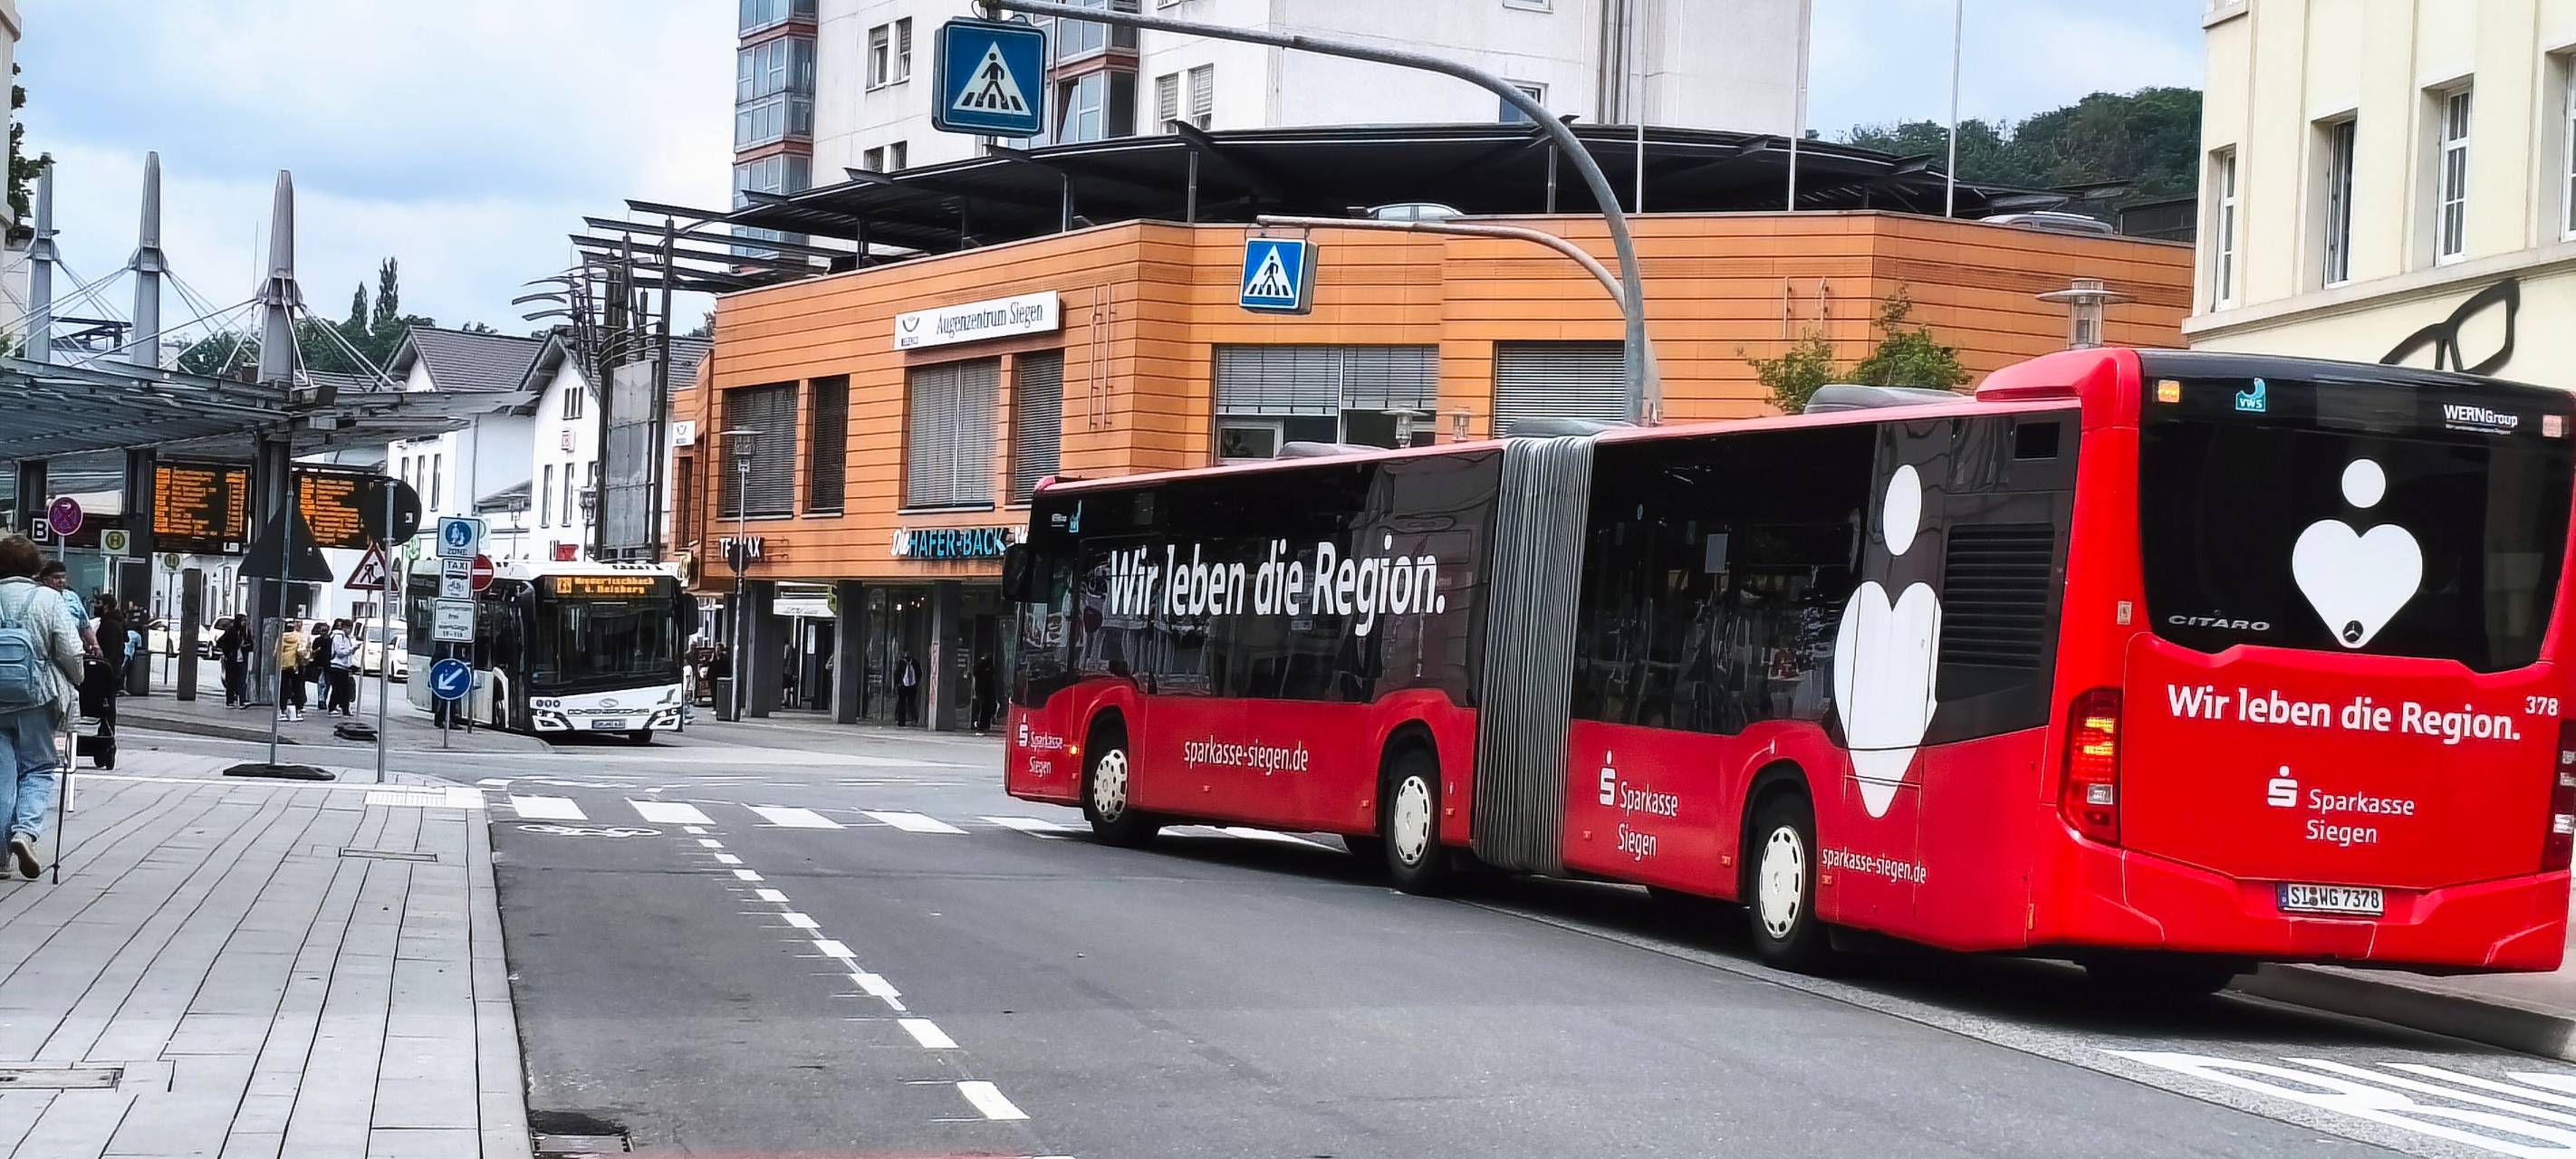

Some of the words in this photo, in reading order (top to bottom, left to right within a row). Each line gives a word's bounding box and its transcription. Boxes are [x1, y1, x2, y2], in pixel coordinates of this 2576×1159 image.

[937, 308, 1006, 338] Augenzentrum
[1009, 302, 1043, 328] Siegen
[2239, 398, 2263, 409] VWS
[34, 520, 47, 539] B
[447, 560, 468, 570] TAXI
[1110, 545, 1158, 616] Wir
[1163, 543, 1245, 616] leben
[1254, 539, 1304, 616] die
[1312, 533, 1447, 637] Region.
[2168, 615, 2271, 631] CITARO
[2167, 684, 2229, 720] Wir
[2238, 687, 2331, 728] leben
[2341, 696, 2391, 732] die
[2401, 701, 2521, 745] Region.
[2525, 695, 2559, 717] 378
[1028, 756, 1052, 778] Siegen
[1184, 734, 1309, 776] sparkasse-siegen.de
[1620, 781, 1678, 817] Sparkasse
[2307, 789, 2416, 816] Sparkasse
[1617, 823, 1657, 861] Siegen
[2306, 819, 2378, 848] Siegen
[1821, 846, 1927, 884] sparkasse-siegen.de
[2291, 886, 2310, 905] SI
[2320, 887, 2339, 906] WG
[2342, 888, 2379, 908] 7378
